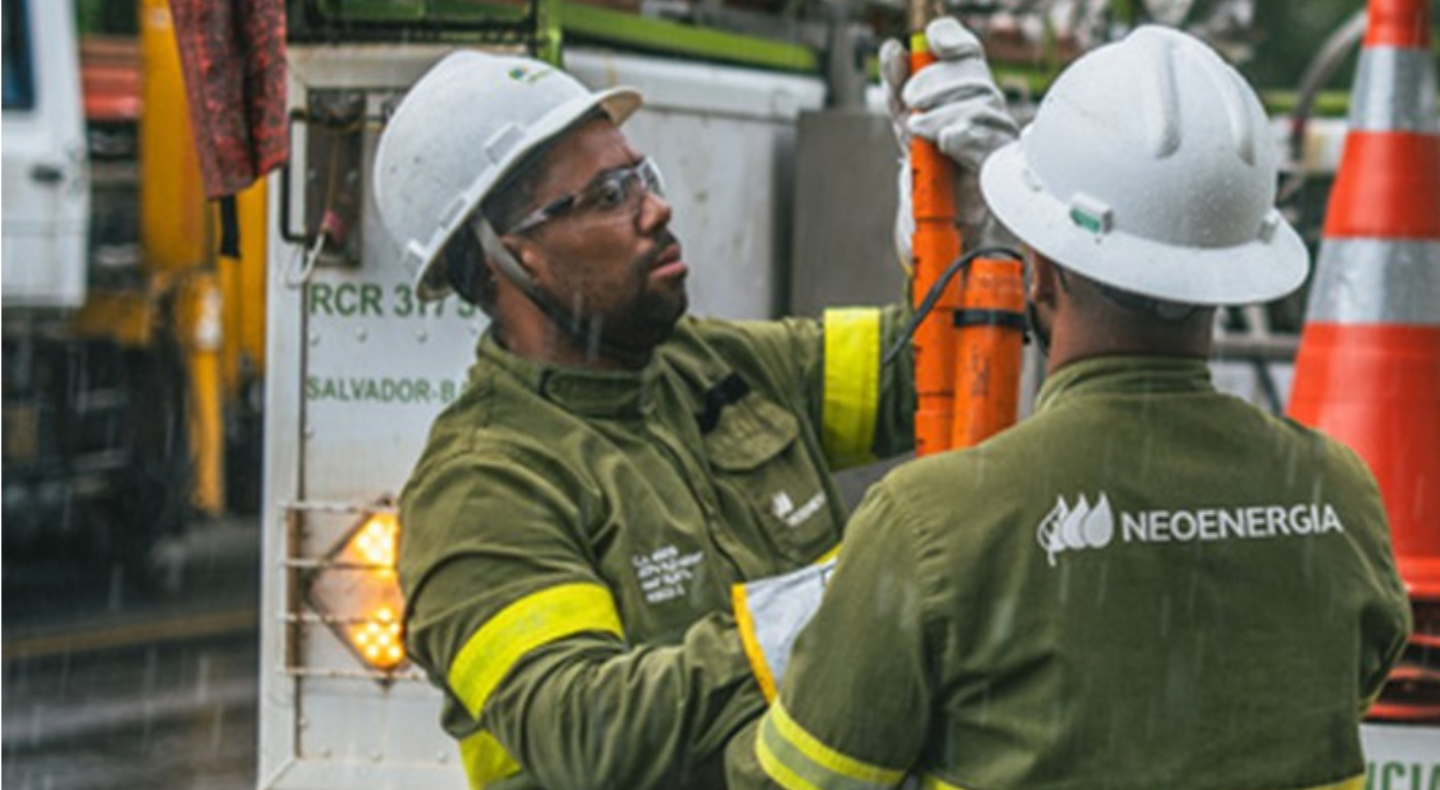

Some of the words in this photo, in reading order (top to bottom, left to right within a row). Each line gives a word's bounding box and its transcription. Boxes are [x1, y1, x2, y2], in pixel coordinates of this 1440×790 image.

[309, 283, 384, 317] RCR
[307, 375, 468, 402] SALVADOR-B
[1120, 502, 1344, 543] NEOENERGIA
